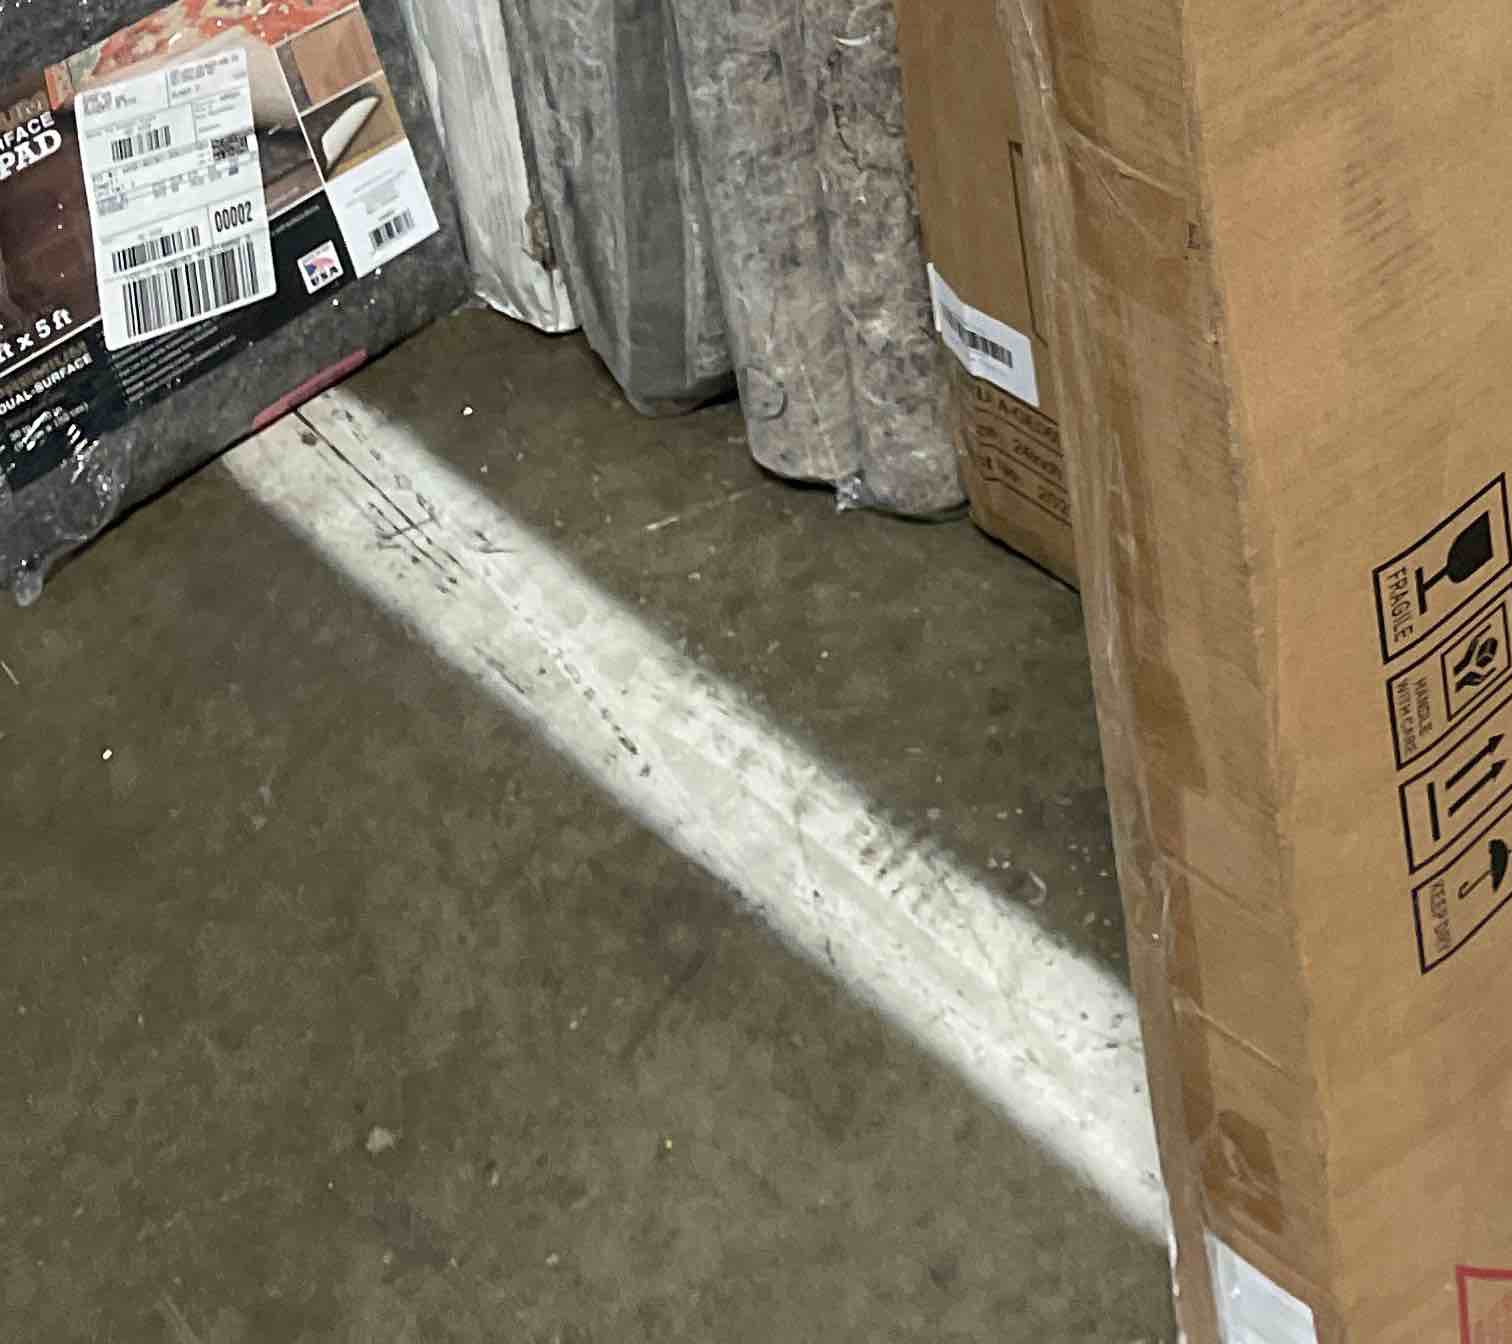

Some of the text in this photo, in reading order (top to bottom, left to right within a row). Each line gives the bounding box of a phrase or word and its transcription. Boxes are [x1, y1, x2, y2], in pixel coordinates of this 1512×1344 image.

[0, 129, 62, 181] PAD
[213, 198, 256, 236] 00002
[16, 332, 34, 351] x
[34, 318, 52, 339] 5
[51, 308, 74, 331] ft
[1384, 565, 1415, 647] FRAGILE
